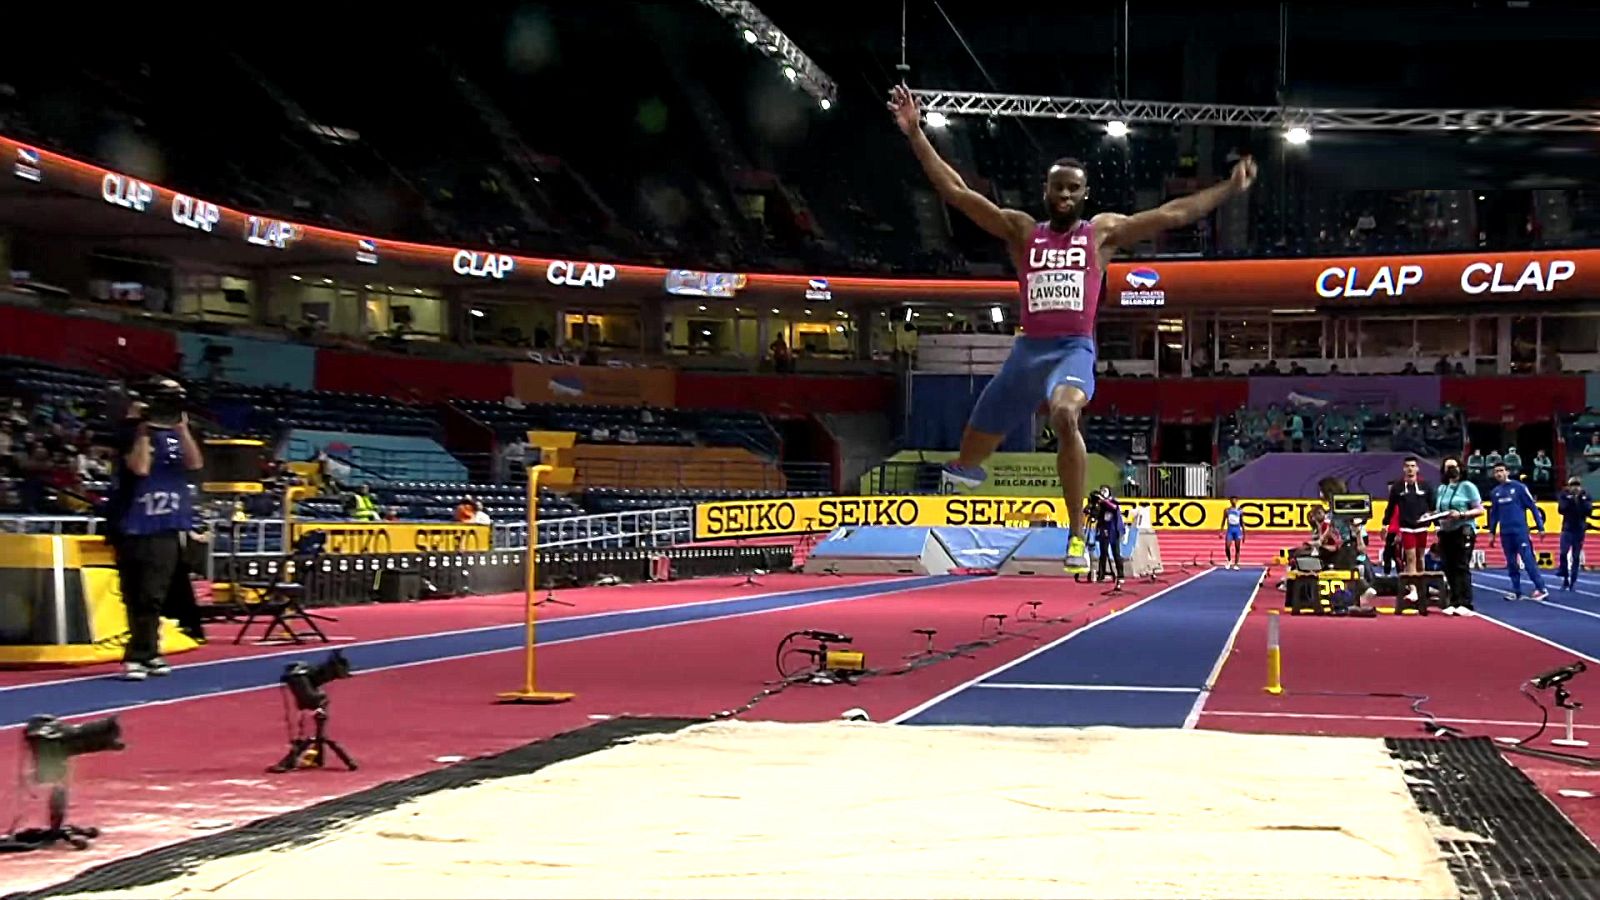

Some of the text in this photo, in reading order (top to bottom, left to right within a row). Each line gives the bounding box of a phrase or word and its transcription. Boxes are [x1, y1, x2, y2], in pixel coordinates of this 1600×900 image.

[102, 173, 153, 212] CLAP
[171, 193, 220, 233] CLAP
[452, 249, 515, 279] CLAP
[1029, 247, 1086, 268] USA
[546, 259, 616, 288] CLAP
[1044, 272, 1076, 283] TDK
[1316, 265, 1423, 298] CLAP
[1461, 260, 1576, 295] CLAP
[1030, 285, 1080, 300] LAWSON
[993, 479, 1048, 487] BELGRADE
[707, 502, 796, 534] SEIKO
[818, 499, 919, 526] SEIKO
[1118, 501, 1206, 527] EIKO
[329, 529, 391, 553] EIKO
[415, 529, 479, 552] SEIKO
